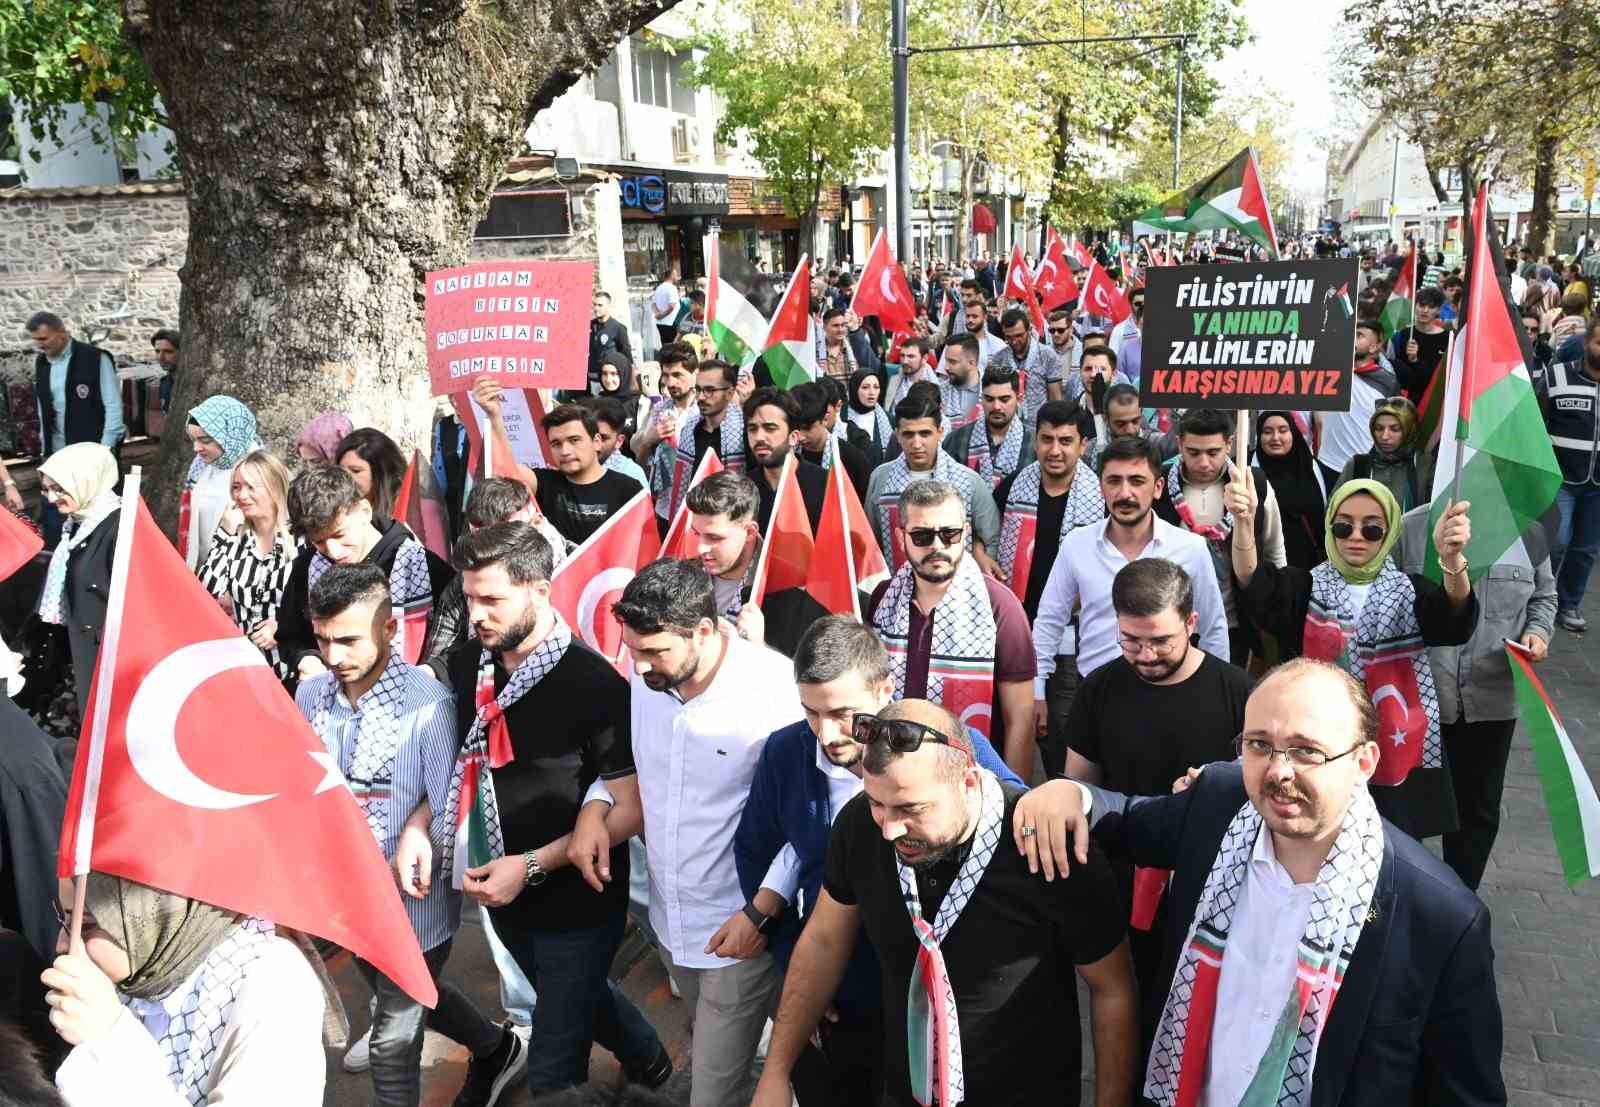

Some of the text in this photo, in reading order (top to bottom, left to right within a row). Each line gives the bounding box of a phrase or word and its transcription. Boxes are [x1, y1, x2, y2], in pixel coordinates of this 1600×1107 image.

[1175, 273, 1315, 308] FİLİSTİN'İN
[1192, 310, 1300, 336] YANINDA
[1168, 333, 1315, 365] ZALİMLERİN
[1151, 370, 1342, 399] KARŞISINDAYIZ
